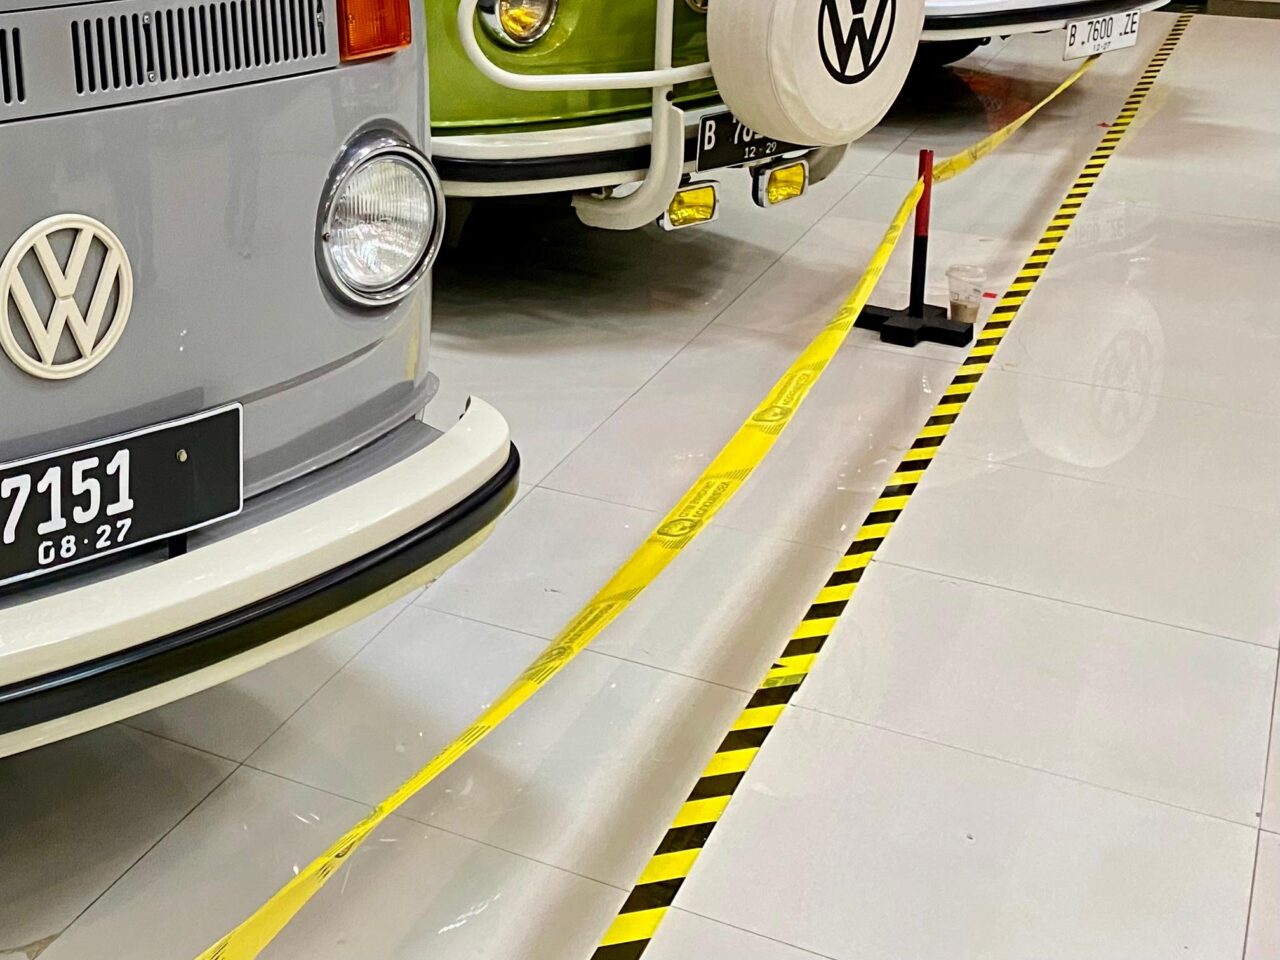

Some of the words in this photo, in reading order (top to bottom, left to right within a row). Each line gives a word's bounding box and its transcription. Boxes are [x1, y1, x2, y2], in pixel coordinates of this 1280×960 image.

[1069, 24, 1077, 47] B
[704, 120, 716, 150] B
[0, 448, 134, 545] 7151
